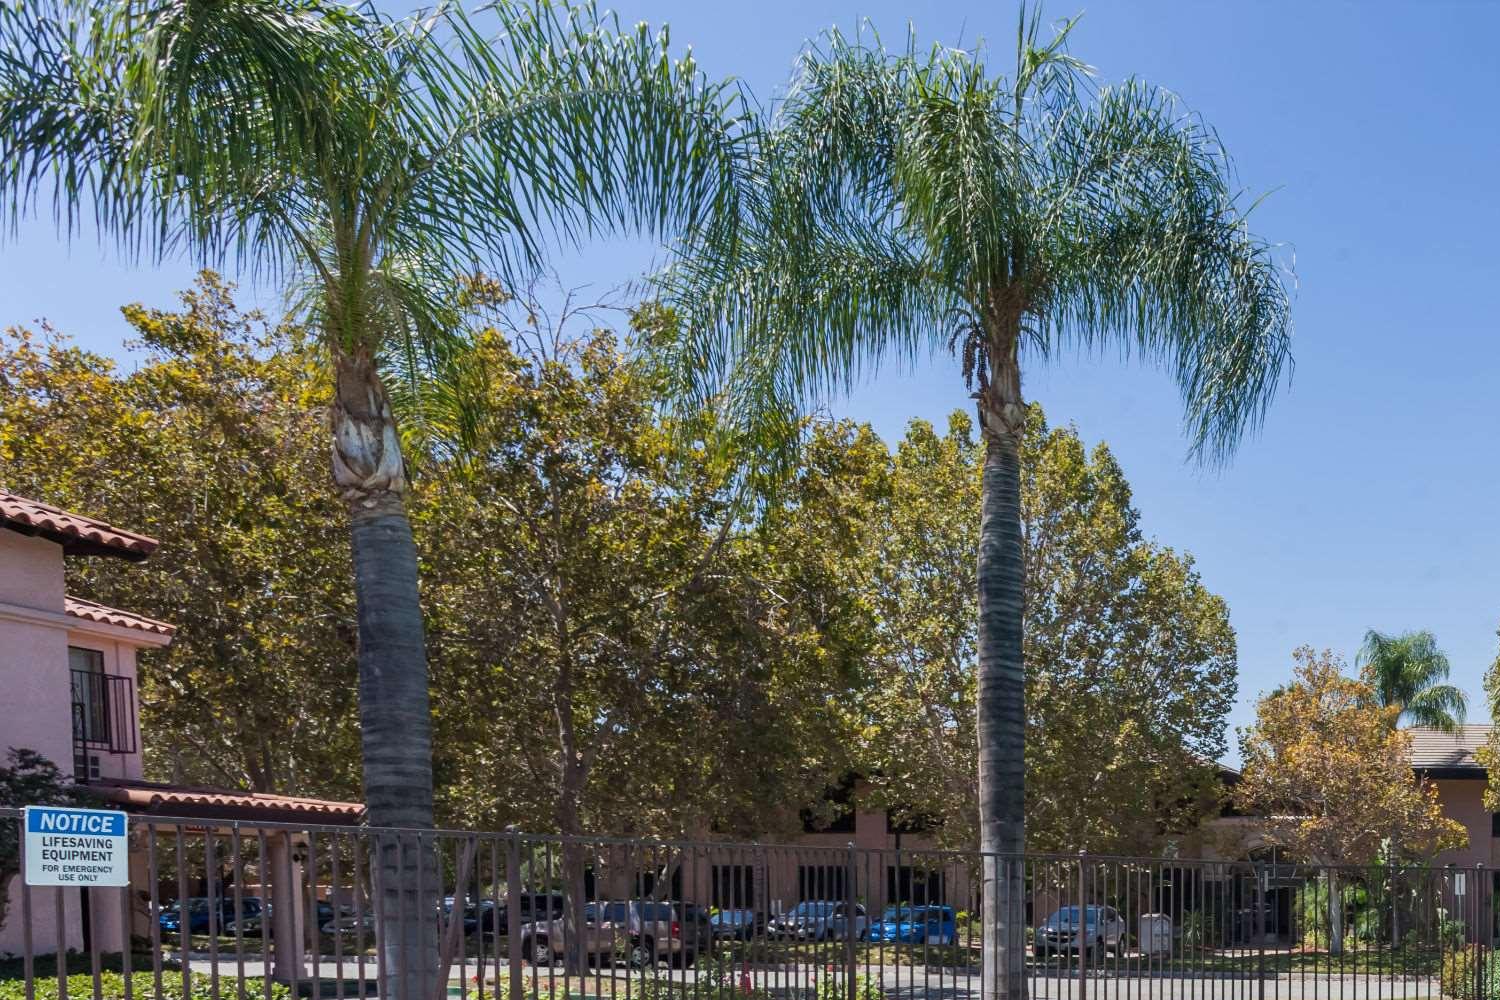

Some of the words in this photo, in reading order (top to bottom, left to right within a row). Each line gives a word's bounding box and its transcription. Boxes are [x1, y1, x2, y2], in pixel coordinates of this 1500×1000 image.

[40, 813, 114, 833] NOTICE
[42, 837, 113, 849] LIFESAVING
[42, 850, 113, 861] EQUIPMENT
[62, 865, 113, 873] EMERGENCY
